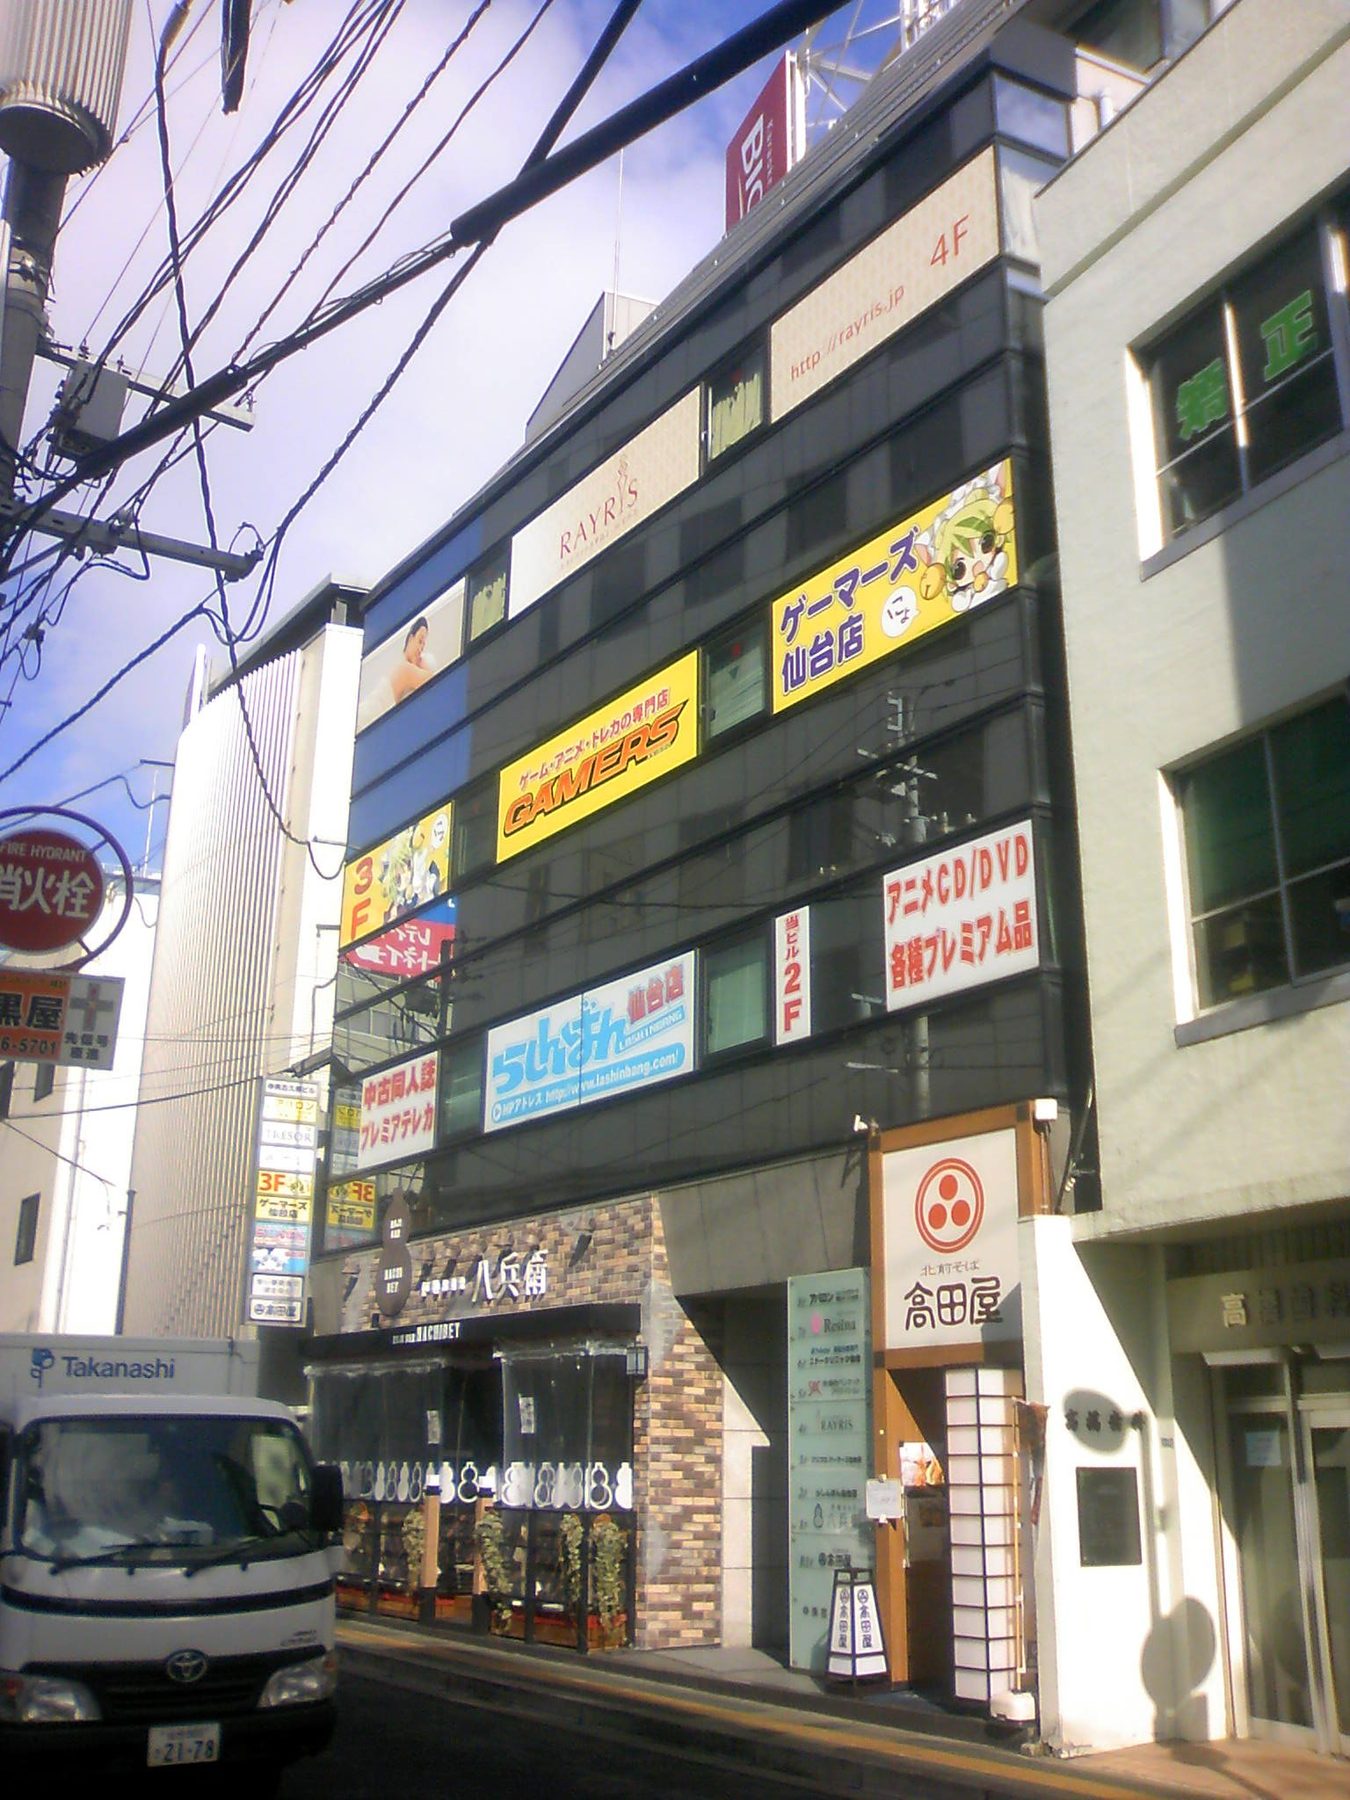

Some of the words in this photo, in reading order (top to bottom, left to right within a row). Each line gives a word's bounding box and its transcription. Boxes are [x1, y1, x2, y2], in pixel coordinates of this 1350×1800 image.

[930, 214, 969, 266] 4F
[781, 526, 919, 643] ゲーマーズ
[781, 613, 864, 694] 仙台店
[503, 699, 689, 837] GAMERS
[887, 834, 1029, 926] アニメCD/DVD
[889, 899, 1034, 991] 各種プレミアム品
[259, 1173, 286, 1192] 3F
[260, 1199, 308, 1211] ゲーマーズ
[904, 1276, 1004, 1331] 高田屋
[61, 1356, 176, 1379] Takanashi
